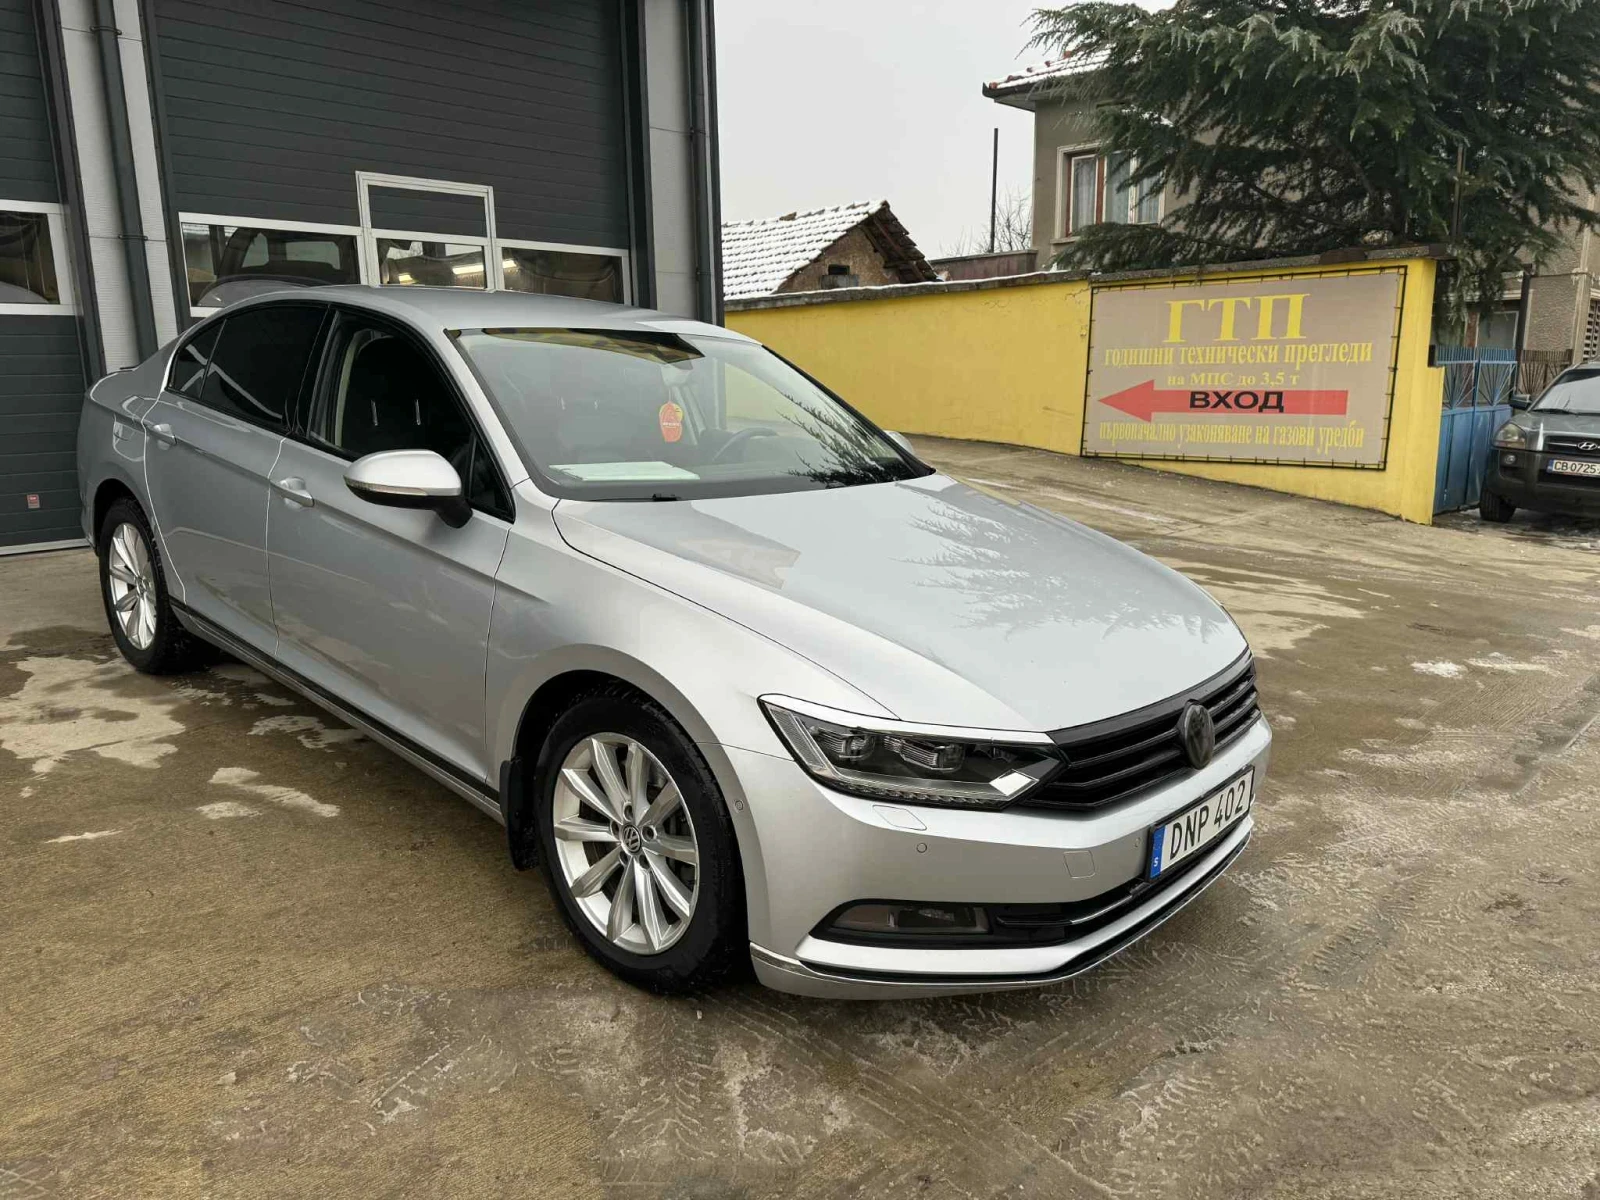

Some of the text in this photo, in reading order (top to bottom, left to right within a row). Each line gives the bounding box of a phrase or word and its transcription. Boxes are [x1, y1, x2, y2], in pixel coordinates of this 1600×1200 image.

[1162, 293, 1311, 343] ГТП
[1104, 342, 1373, 371] годишни технически прегледи
[1167, 374, 1185, 386] на
[1190, 372, 1234, 386] МПС
[1237, 374, 1256, 387] до
[1260, 371, 1285, 387] 3,5
[1189, 390, 1285, 413] ВХОД
[1099, 420, 1365, 456] първоначално узаконяване на газови уредби
[1169, 779, 1246, 860] DNP 402
[1153, 857, 1159, 867] S
